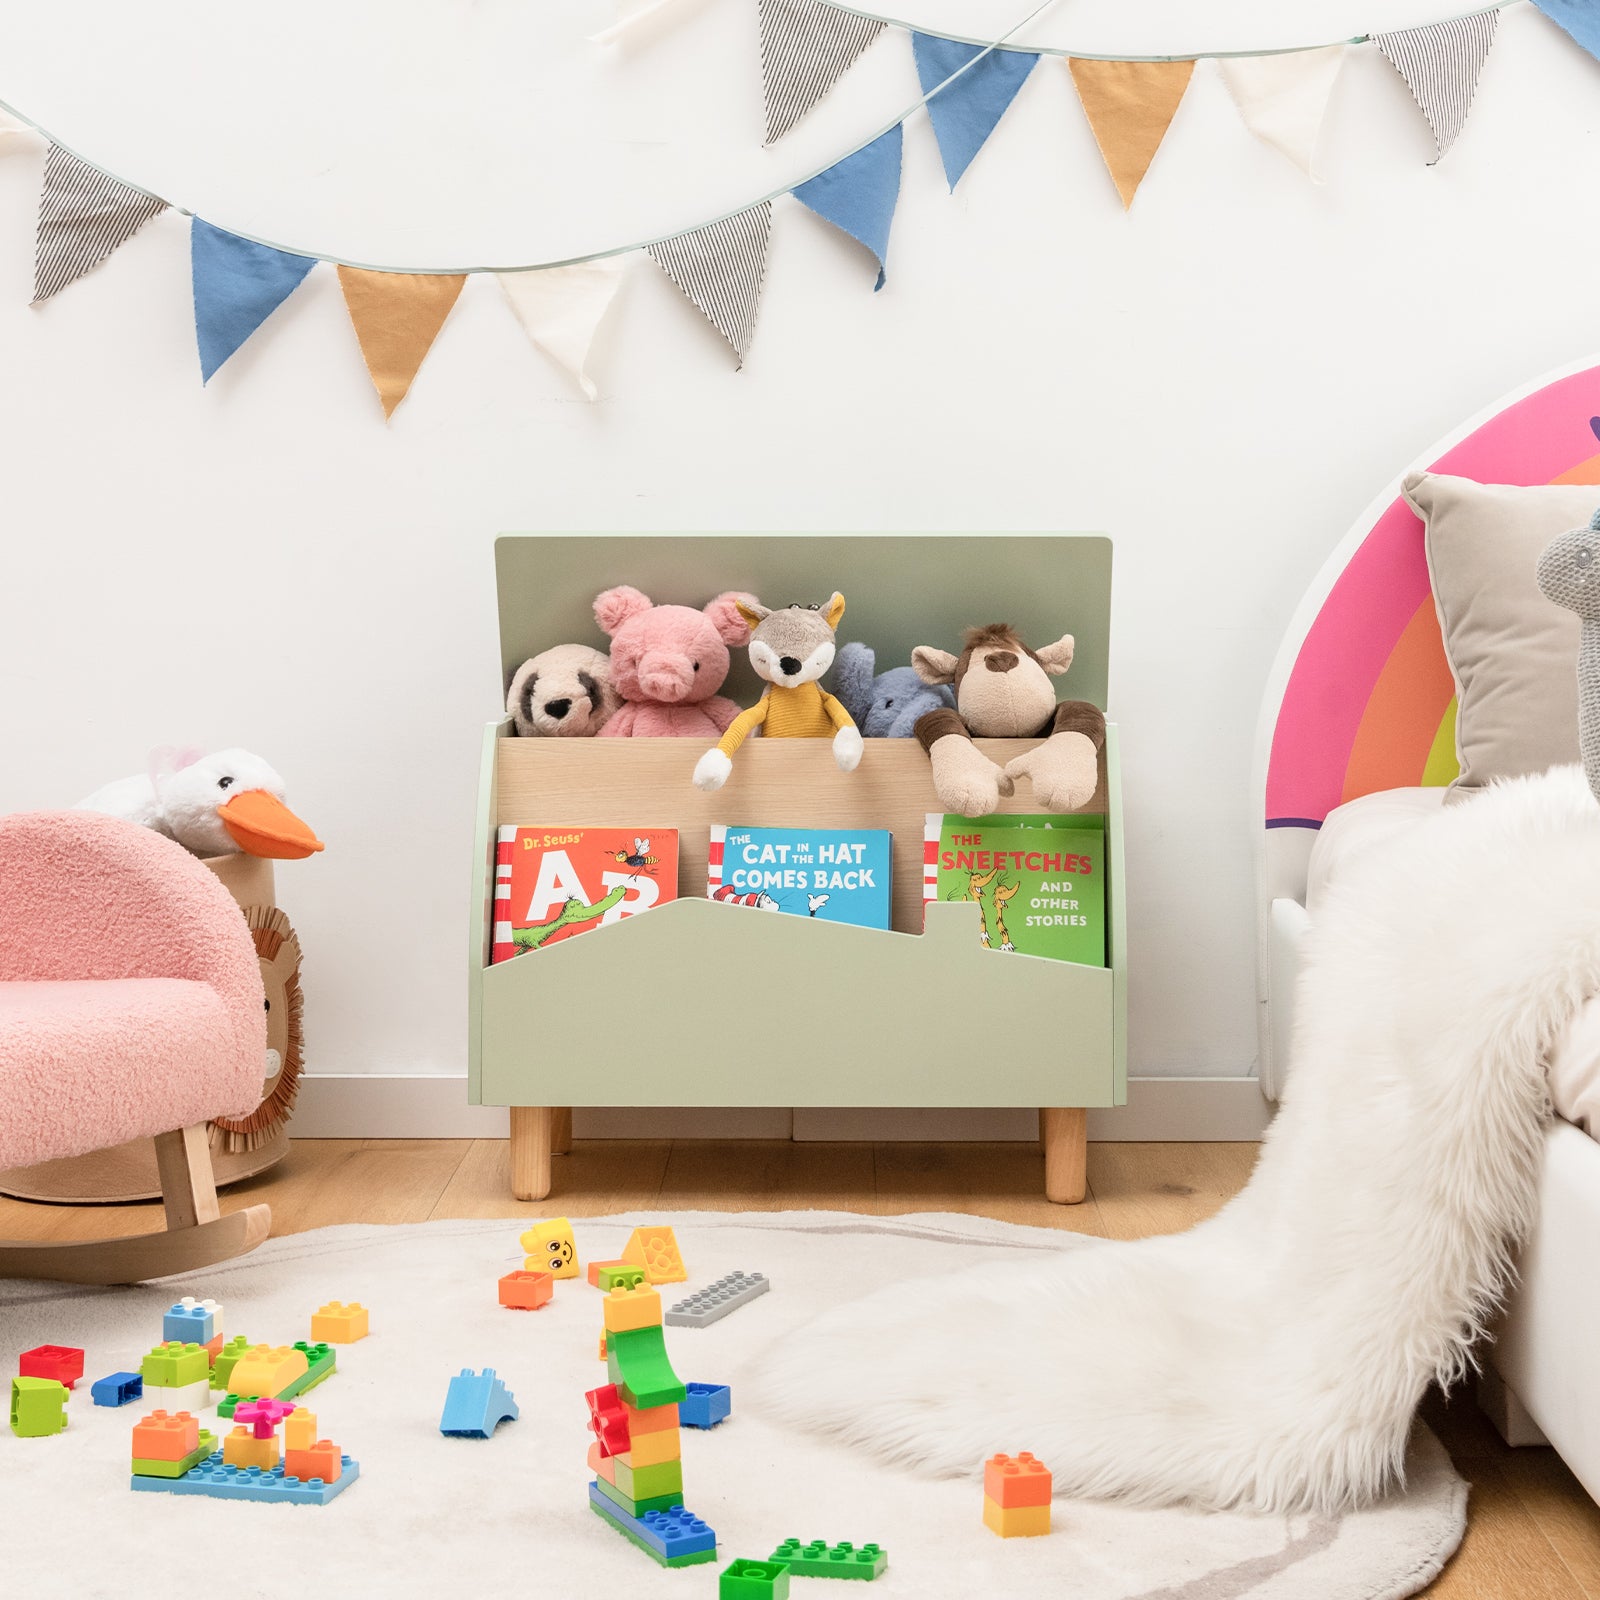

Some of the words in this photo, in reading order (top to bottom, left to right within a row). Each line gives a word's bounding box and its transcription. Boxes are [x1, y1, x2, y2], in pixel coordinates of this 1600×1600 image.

[523, 837, 542, 851] Dr.
[543, 832, 585, 848] Seuss'
[729, 834, 751, 845] THE
[951, 834, 982, 846] THE
[742, 843, 791, 864] CAT
[797, 843, 809, 852] IN
[818, 843, 867, 864] HAT
[792, 854, 814, 864] THE
[941, 850, 1093, 875] SNEETCHES
[732, 869, 808, 889] COMES
[814, 868, 876, 890] BACK
[1040, 881, 1073, 893] AND
[1030, 897, 1079, 910] OTHER
[1025, 915, 1087, 927] STORIES
